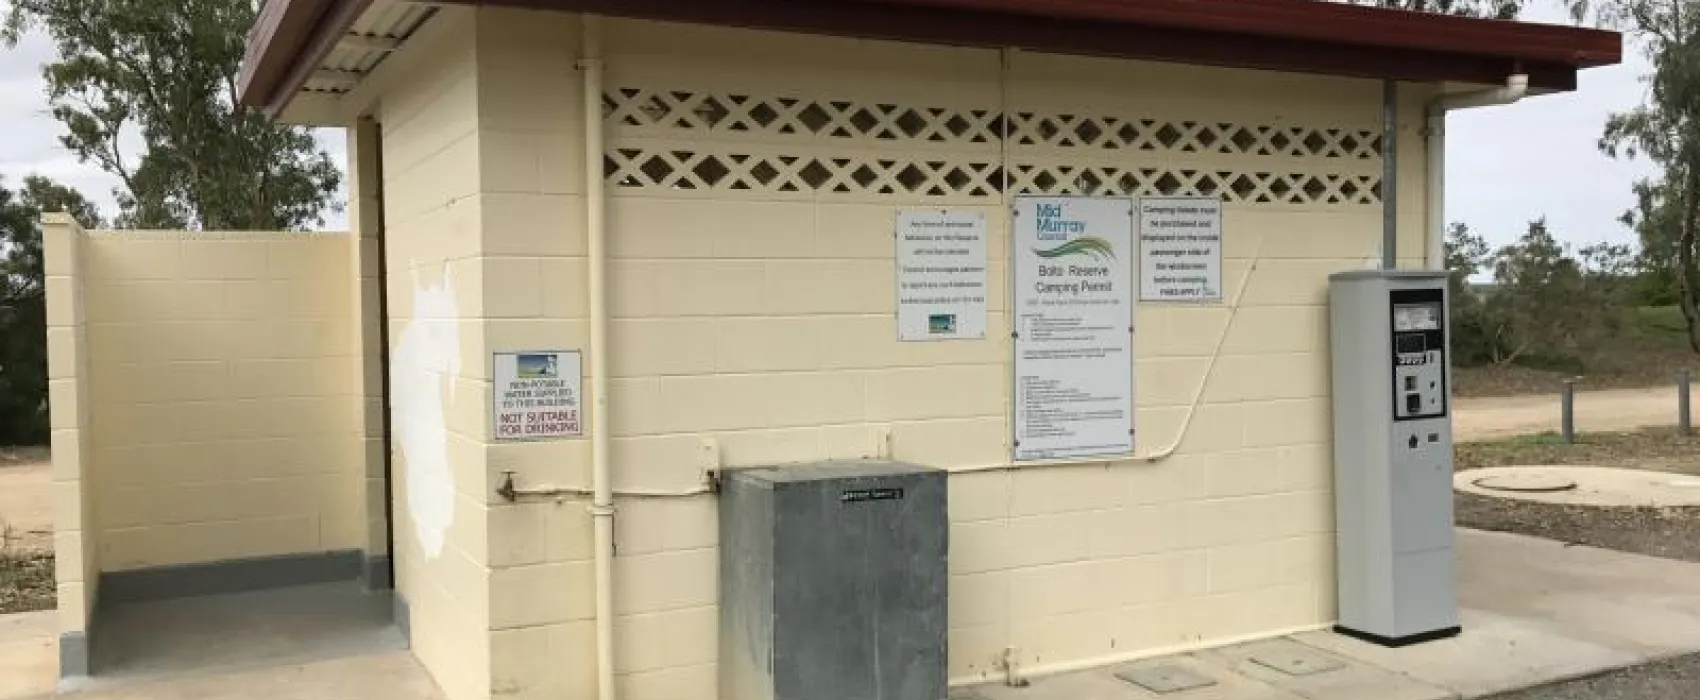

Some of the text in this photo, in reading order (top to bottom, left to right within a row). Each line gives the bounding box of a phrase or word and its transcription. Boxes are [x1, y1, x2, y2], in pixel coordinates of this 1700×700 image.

[1036, 203, 1061, 217] Mid
[1036, 218, 1086, 233] Murray
[1069, 265, 1109, 277] Reserve
[1035, 281, 1113, 296] Camping Permit
[500, 409, 577, 423] NOT SUITABLE
[500, 421, 579, 435] FOR DRINKING
